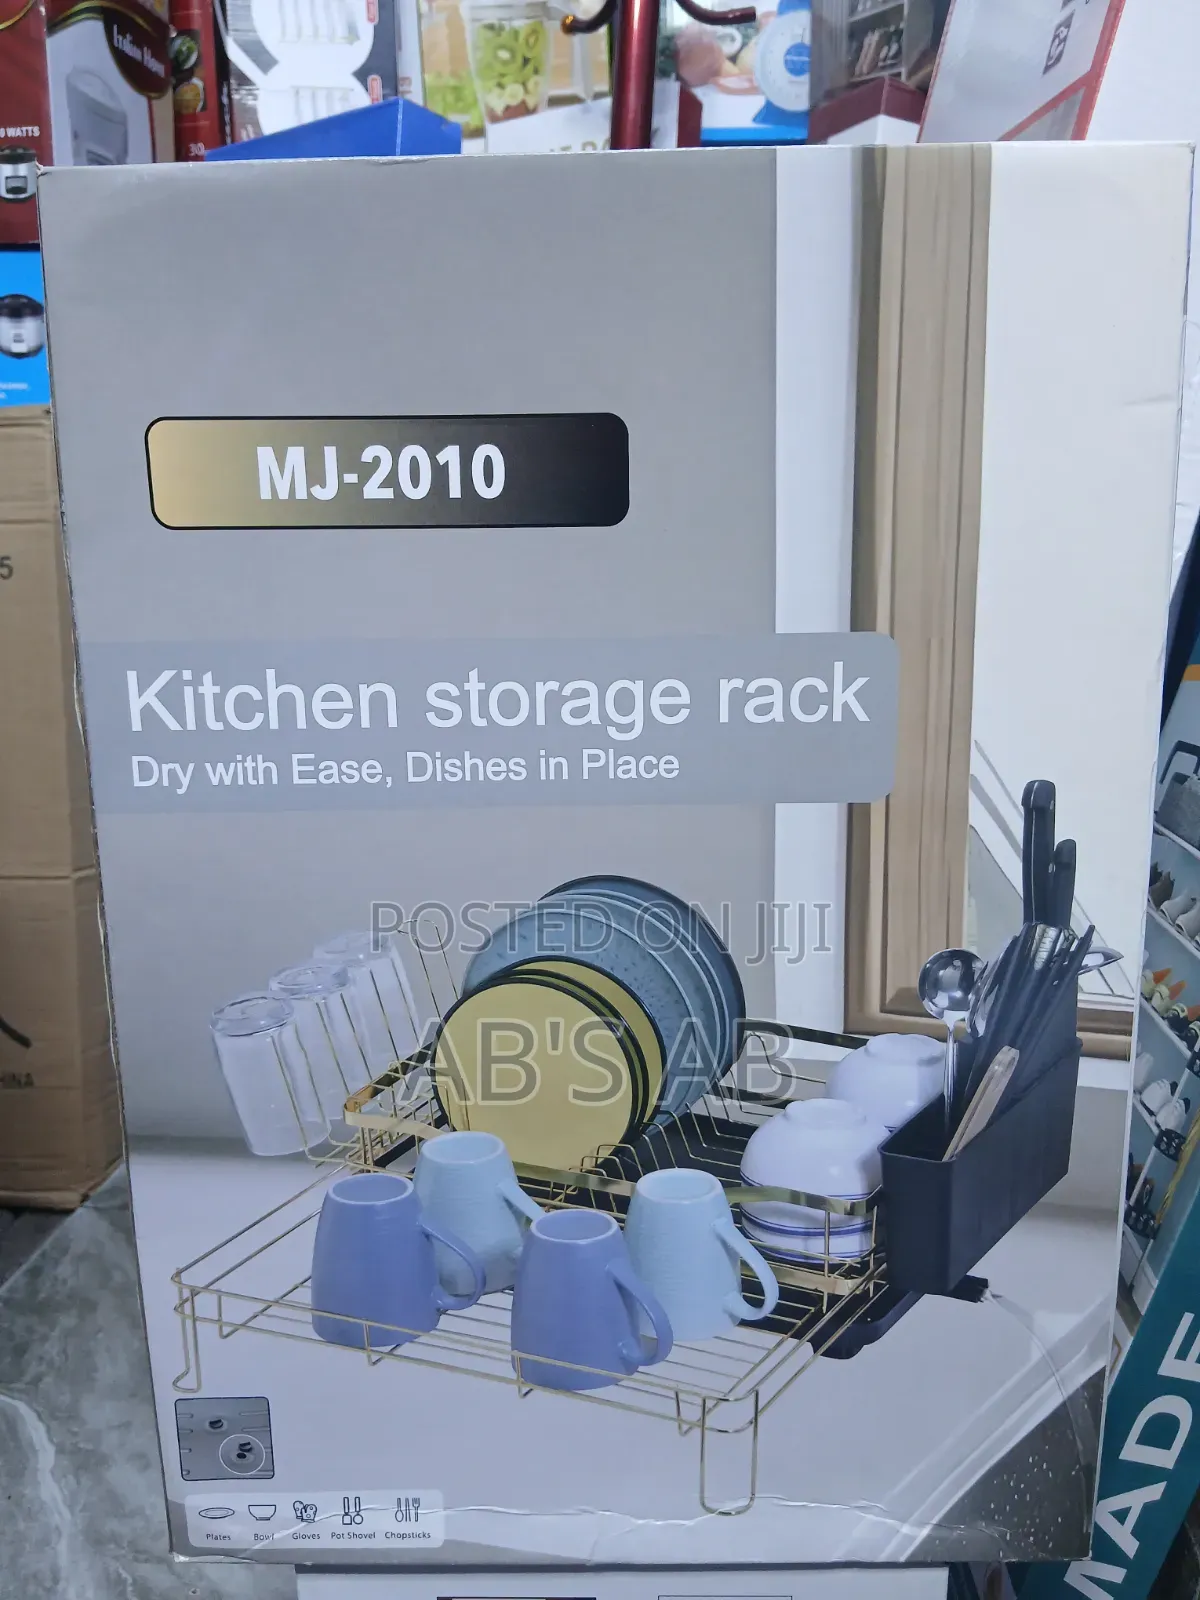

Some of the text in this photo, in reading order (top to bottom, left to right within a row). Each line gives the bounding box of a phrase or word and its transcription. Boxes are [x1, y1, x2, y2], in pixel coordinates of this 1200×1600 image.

[6, 126, 40, 138] WATTS
[256, 443, 506, 501] MJ-2010
[126, 661, 871, 741] Kitchen storage rack
[131, 748, 680, 795] Dry with Ease, Dishes in Place
[205, 1532, 232, 1542] Plates
[253, 1531, 275, 1541] Bowl
[291, 1531, 321, 1541] Gloves
[330, 1530, 376, 1540] Pot Shovel
[384, 1530, 432, 1542] Chopsticks
